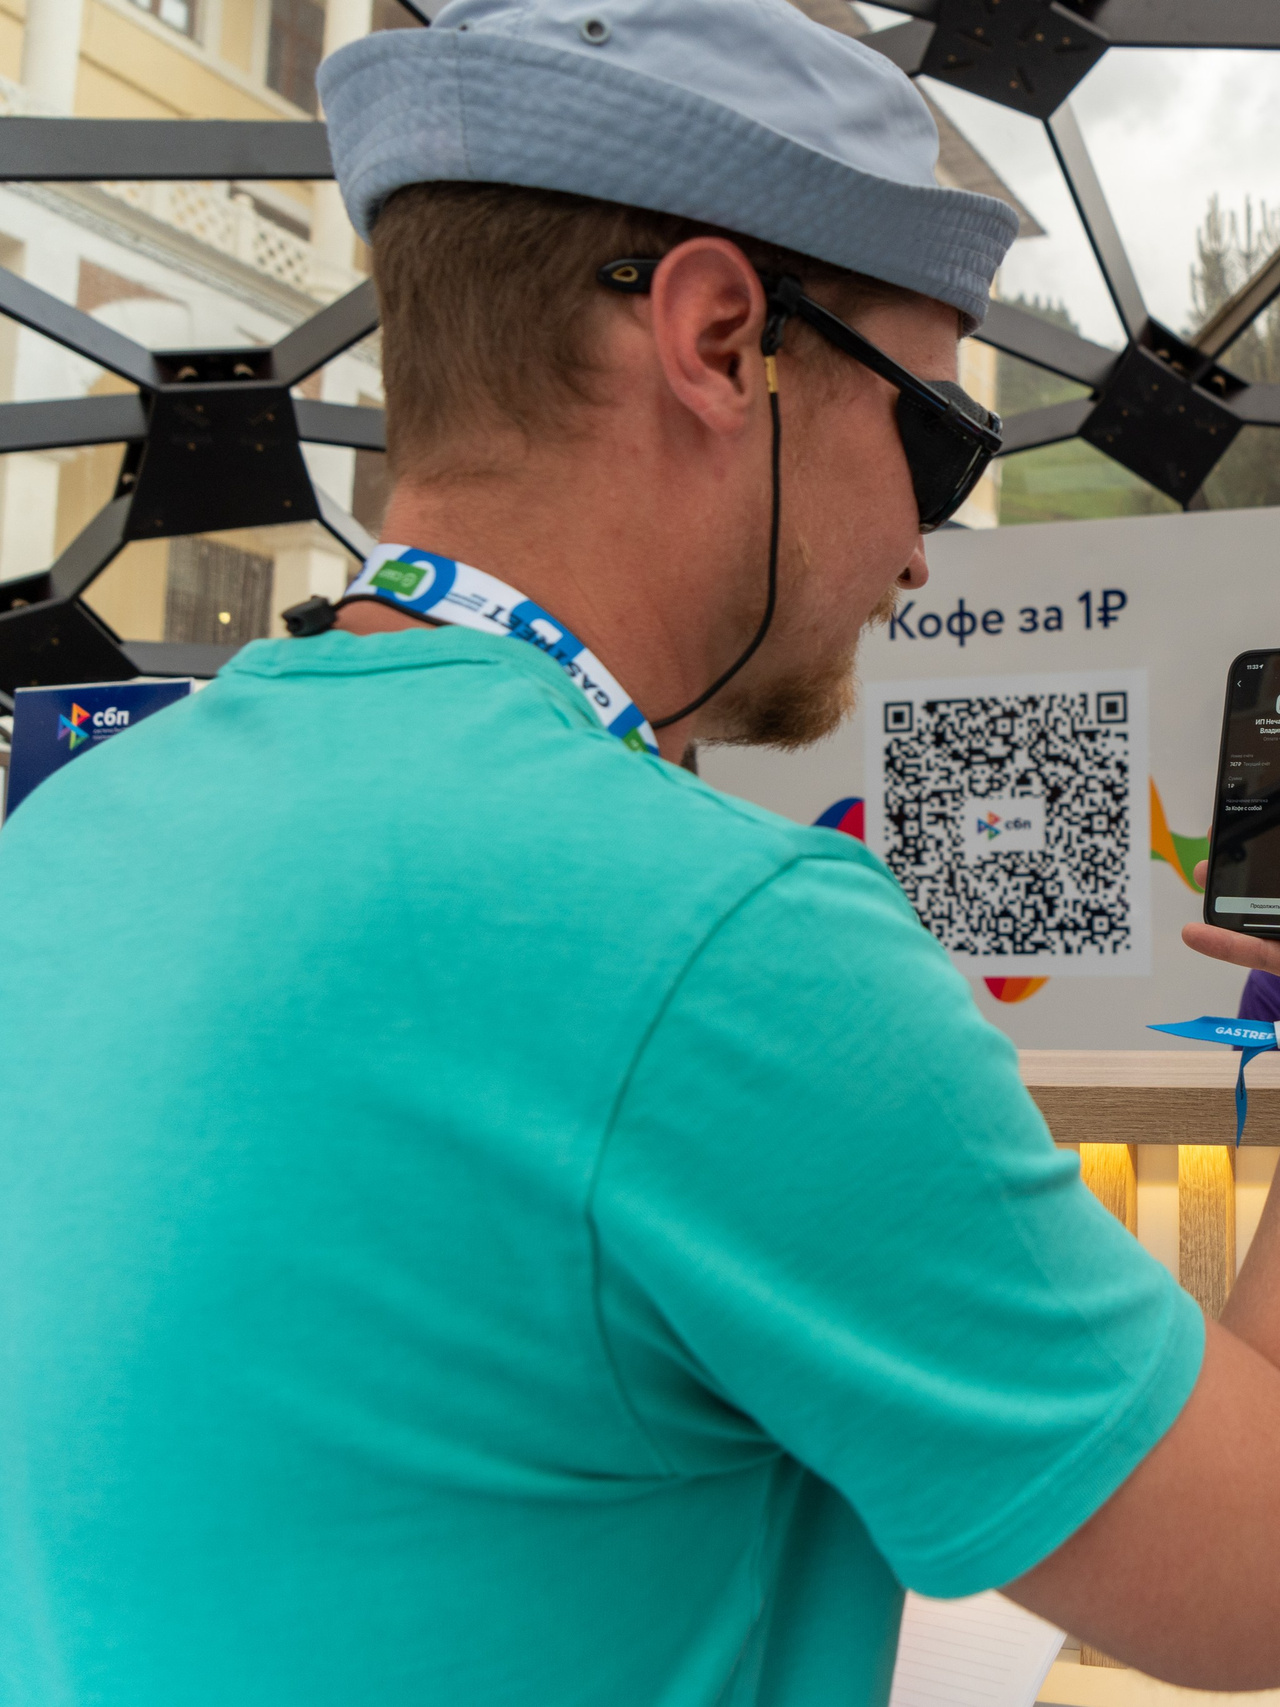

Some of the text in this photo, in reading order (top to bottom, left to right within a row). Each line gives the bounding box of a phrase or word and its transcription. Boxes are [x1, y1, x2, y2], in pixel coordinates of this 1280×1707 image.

[888, 588, 1129, 648] Кофе за 1₽
[92, 707, 130, 727] сбп
[1004, 817, 1032, 830] сбп
